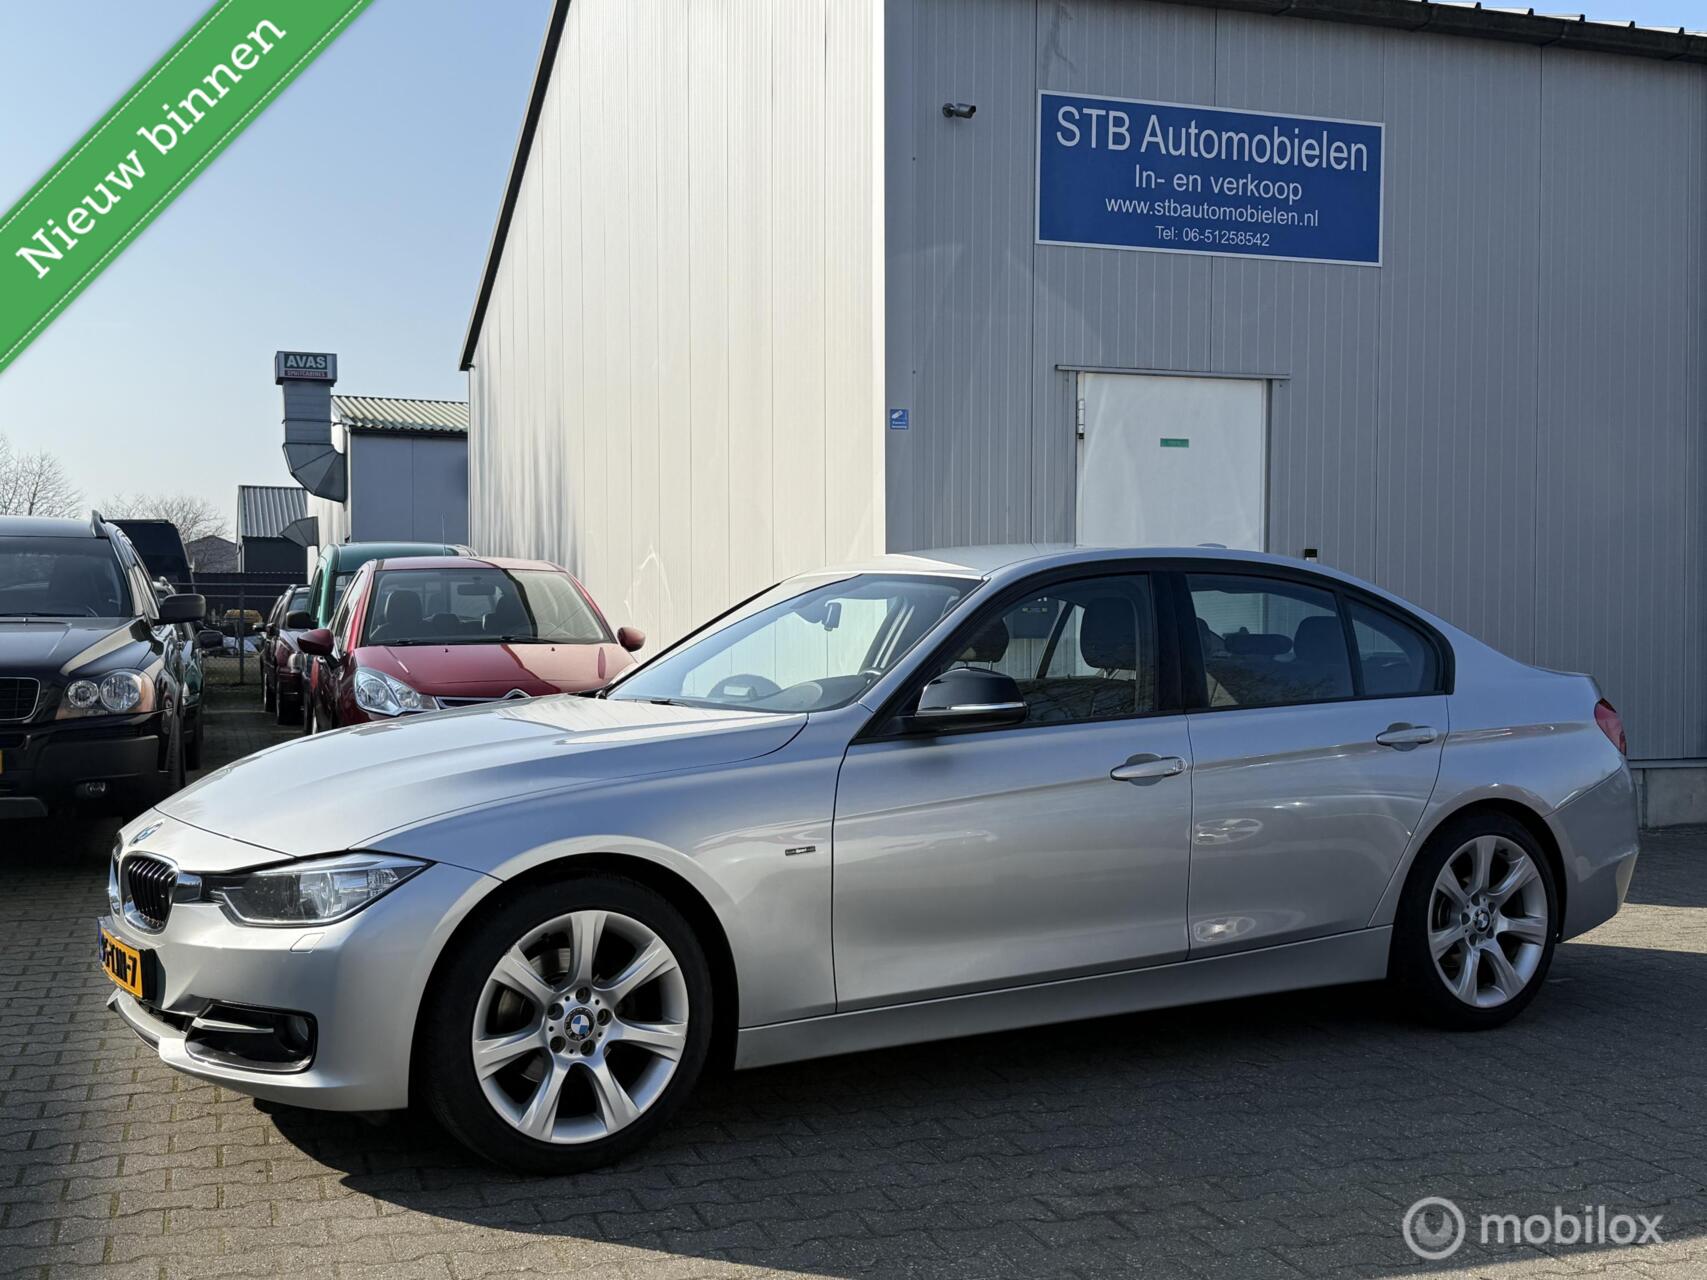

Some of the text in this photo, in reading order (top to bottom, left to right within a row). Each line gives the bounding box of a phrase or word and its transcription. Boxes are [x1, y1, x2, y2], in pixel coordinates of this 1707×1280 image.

[1056, 105, 1368, 172] STB Automobielen
[1135, 164, 1303, 205] In- en verkoop
[1105, 197, 1319, 227] www.stbautomobielen.nl
[1155, 225, 1271, 248] Tel: 06-51258542
[286, 355, 326, 368] AVAS
